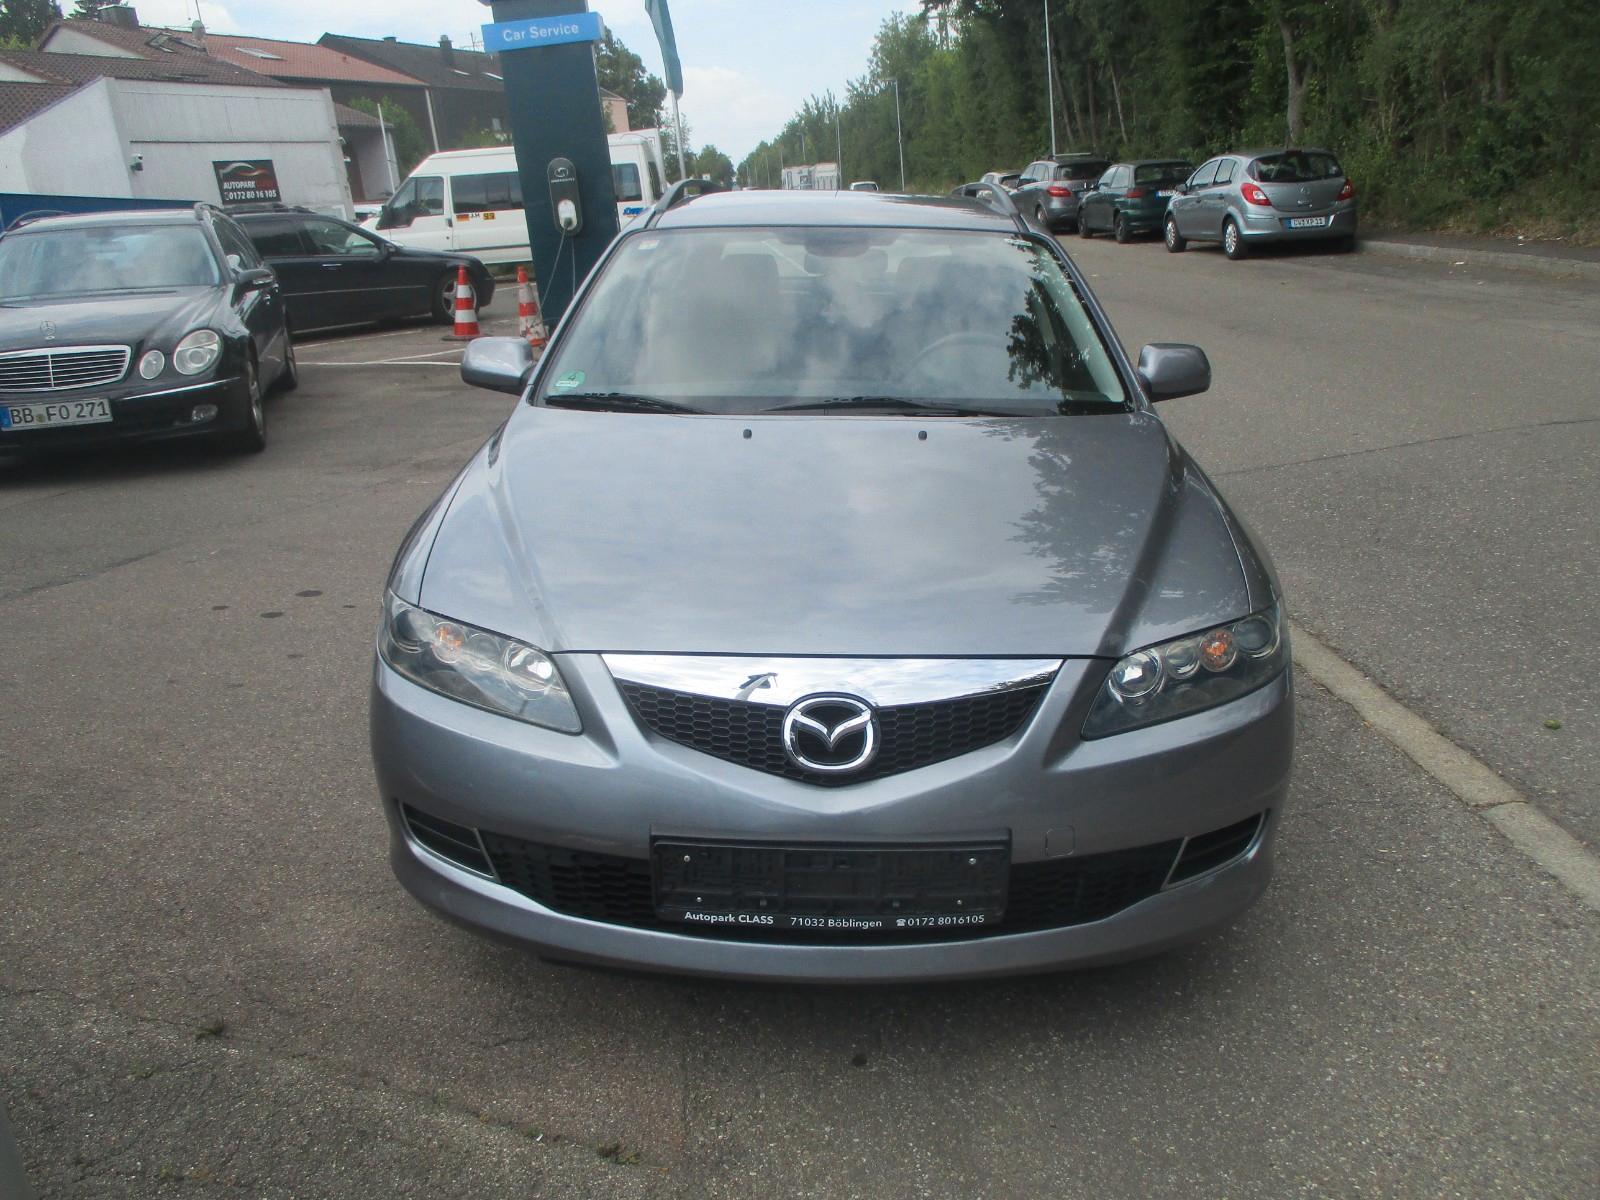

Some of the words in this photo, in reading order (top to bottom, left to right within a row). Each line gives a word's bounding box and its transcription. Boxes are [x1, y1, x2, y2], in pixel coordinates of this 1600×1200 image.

[503, 28, 526, 42] Car
[529, 23, 580, 39] Service
[223, 181, 256, 190] AUTOPARK
[10, 408, 34, 424] BB
[45, 404, 70, 421] FO
[75, 401, 109, 418] 271
[684, 911, 735, 924] Autopark
[738, 914, 774, 925] CLASS
[790, 917, 825, 927] 71032
[828, 918, 882, 929] Böblingen
[908, 917, 935, 926] 0172
[938, 914, 985, 925] 8016105
